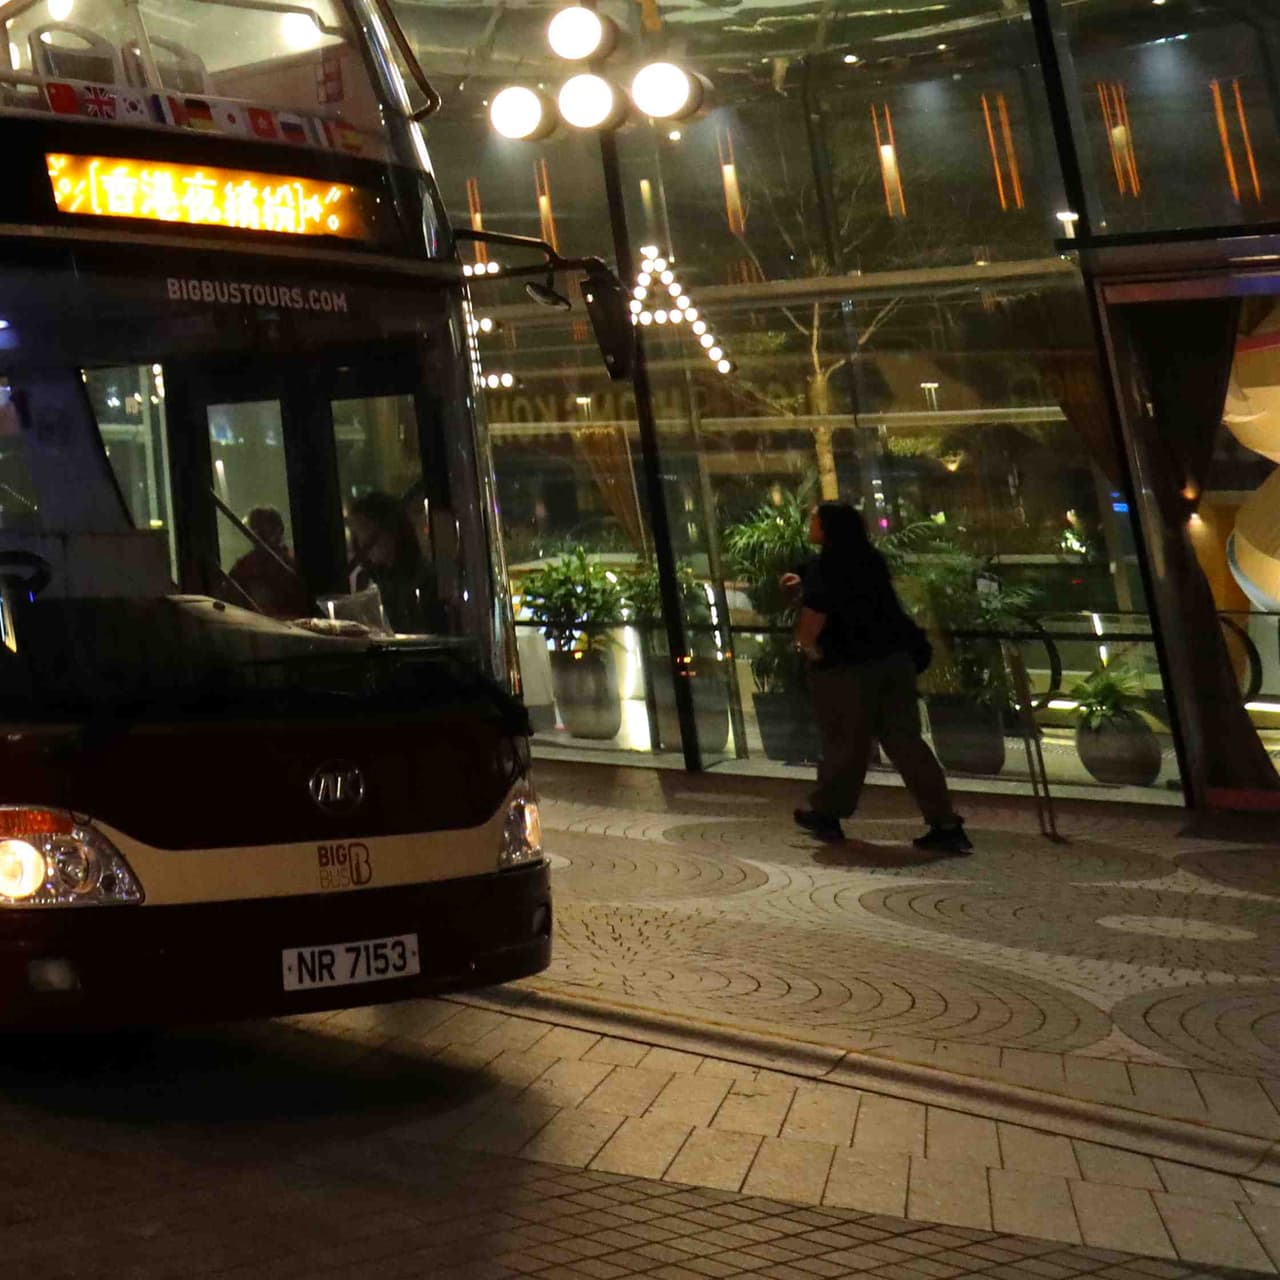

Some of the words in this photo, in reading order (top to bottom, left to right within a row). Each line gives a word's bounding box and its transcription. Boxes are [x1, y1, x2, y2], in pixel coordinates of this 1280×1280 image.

[167, 277, 348, 312] BIGBUSTOURS.COM
[318, 845, 347, 868] BIG
[297, 949, 336, 984] NR
[345, 940, 407, 979] 7153
